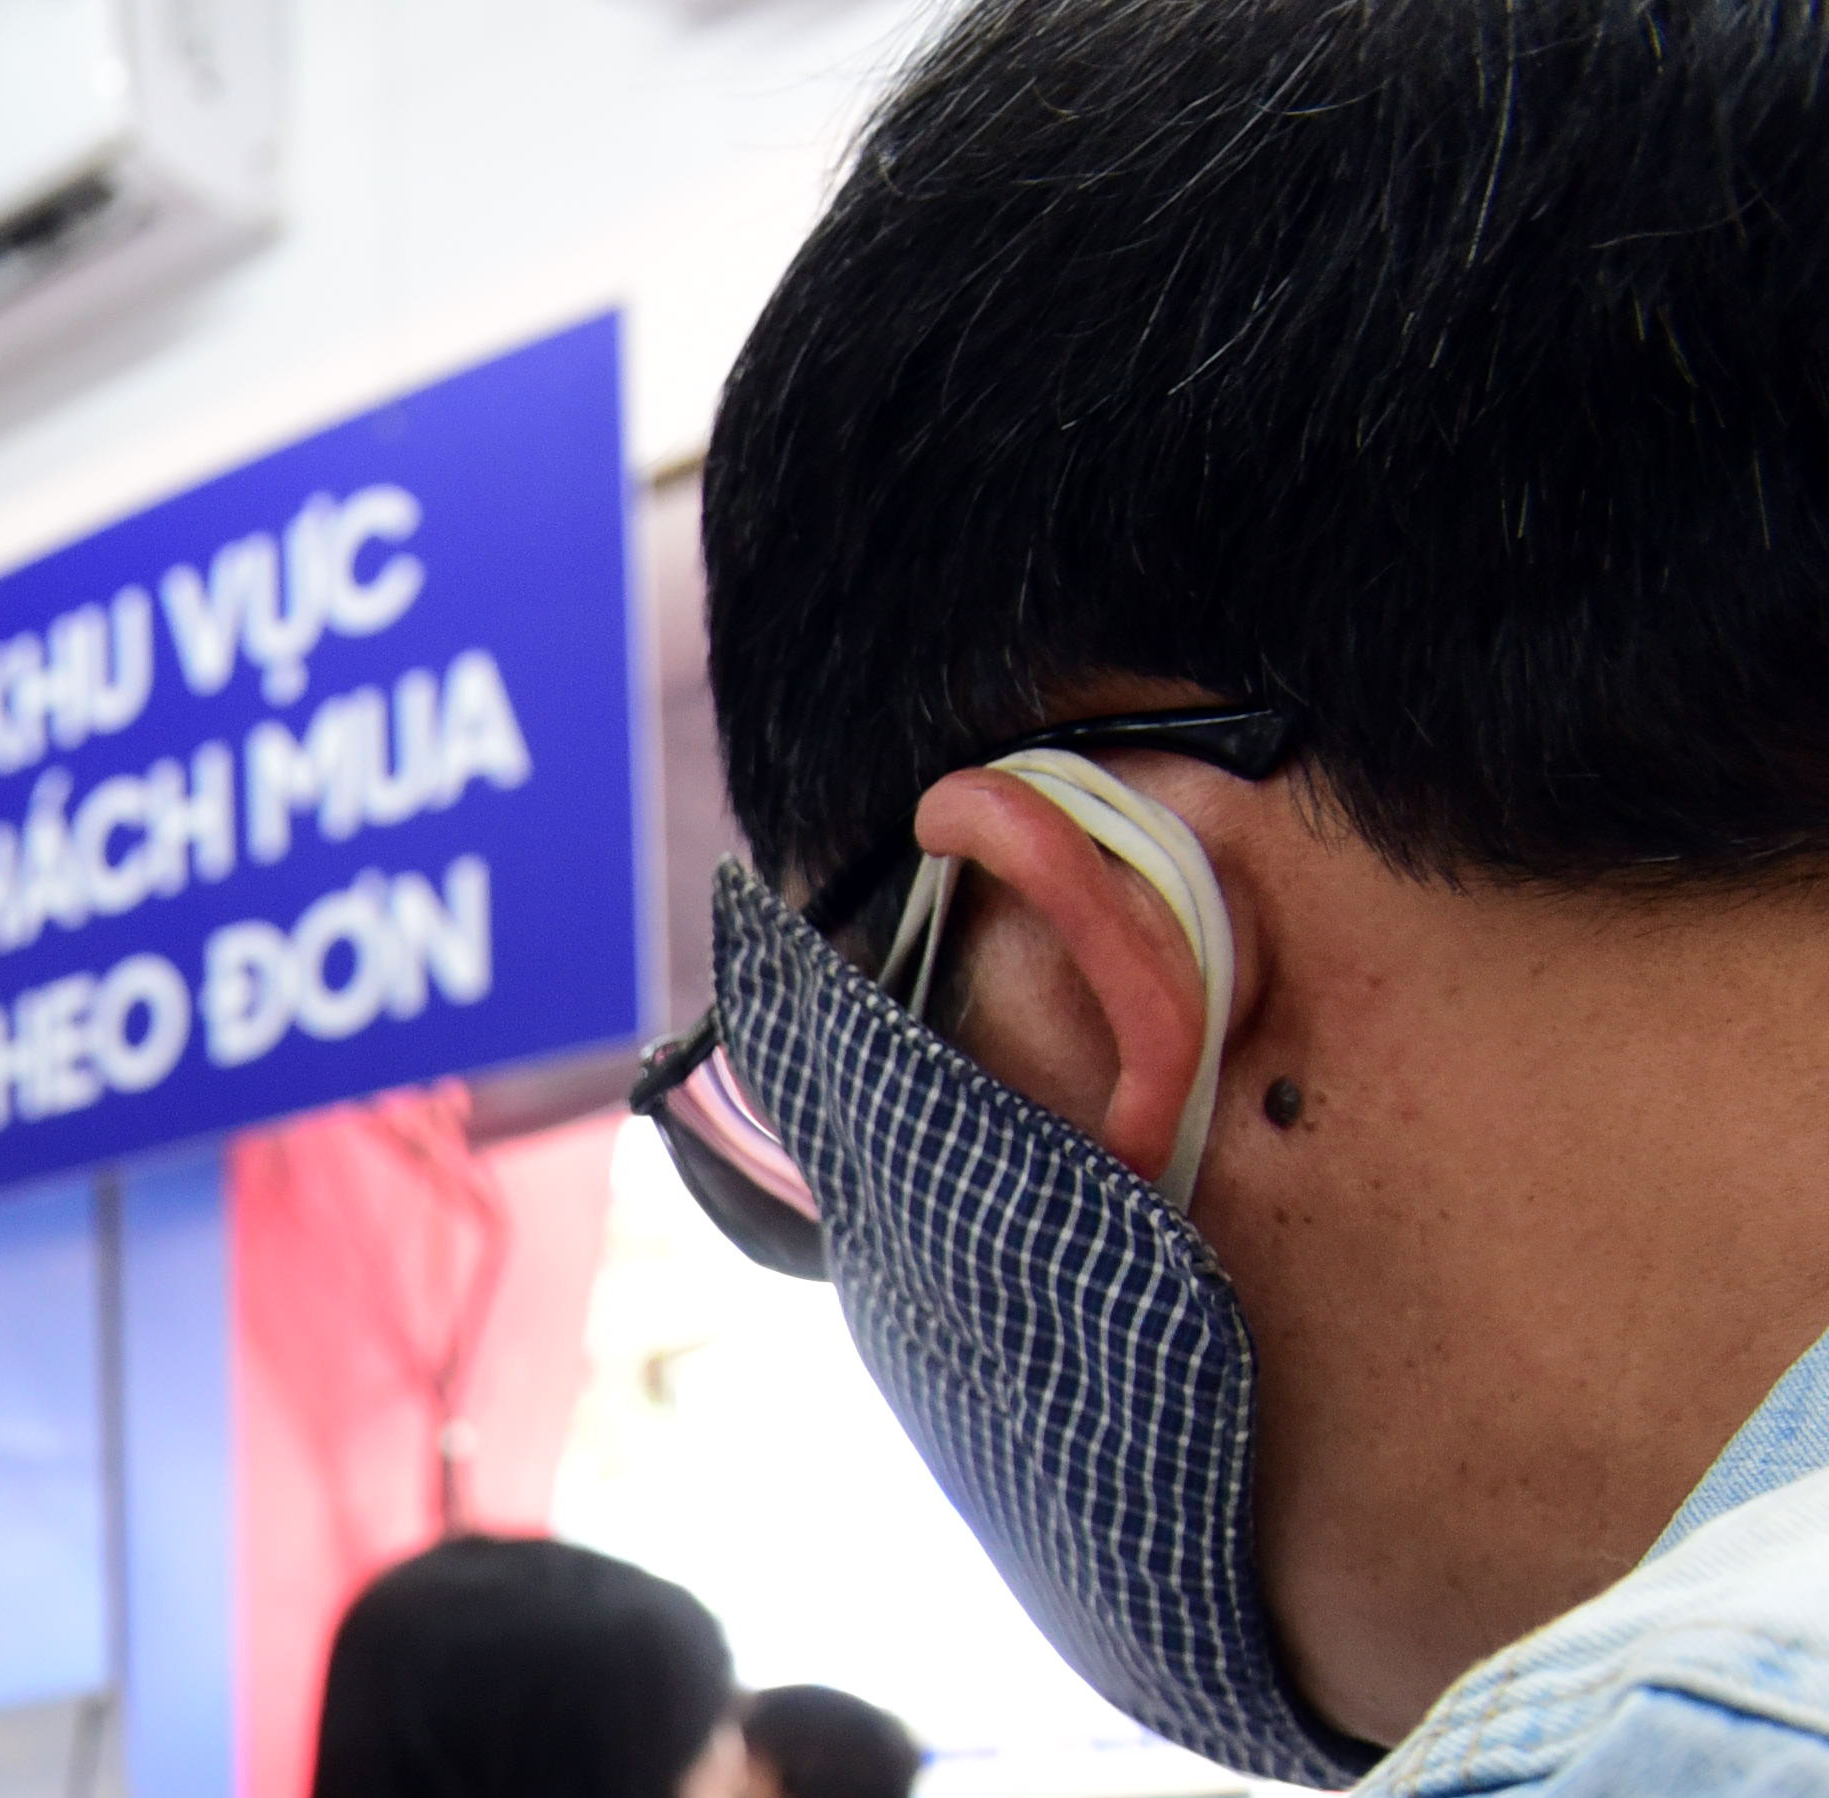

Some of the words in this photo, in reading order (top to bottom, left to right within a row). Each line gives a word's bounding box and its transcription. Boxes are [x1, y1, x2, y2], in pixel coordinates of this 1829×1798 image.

[159, 483, 425, 707] VỰC
[245, 648, 534, 863] MUA
[200, 853, 492, 1069] ĐƠN
